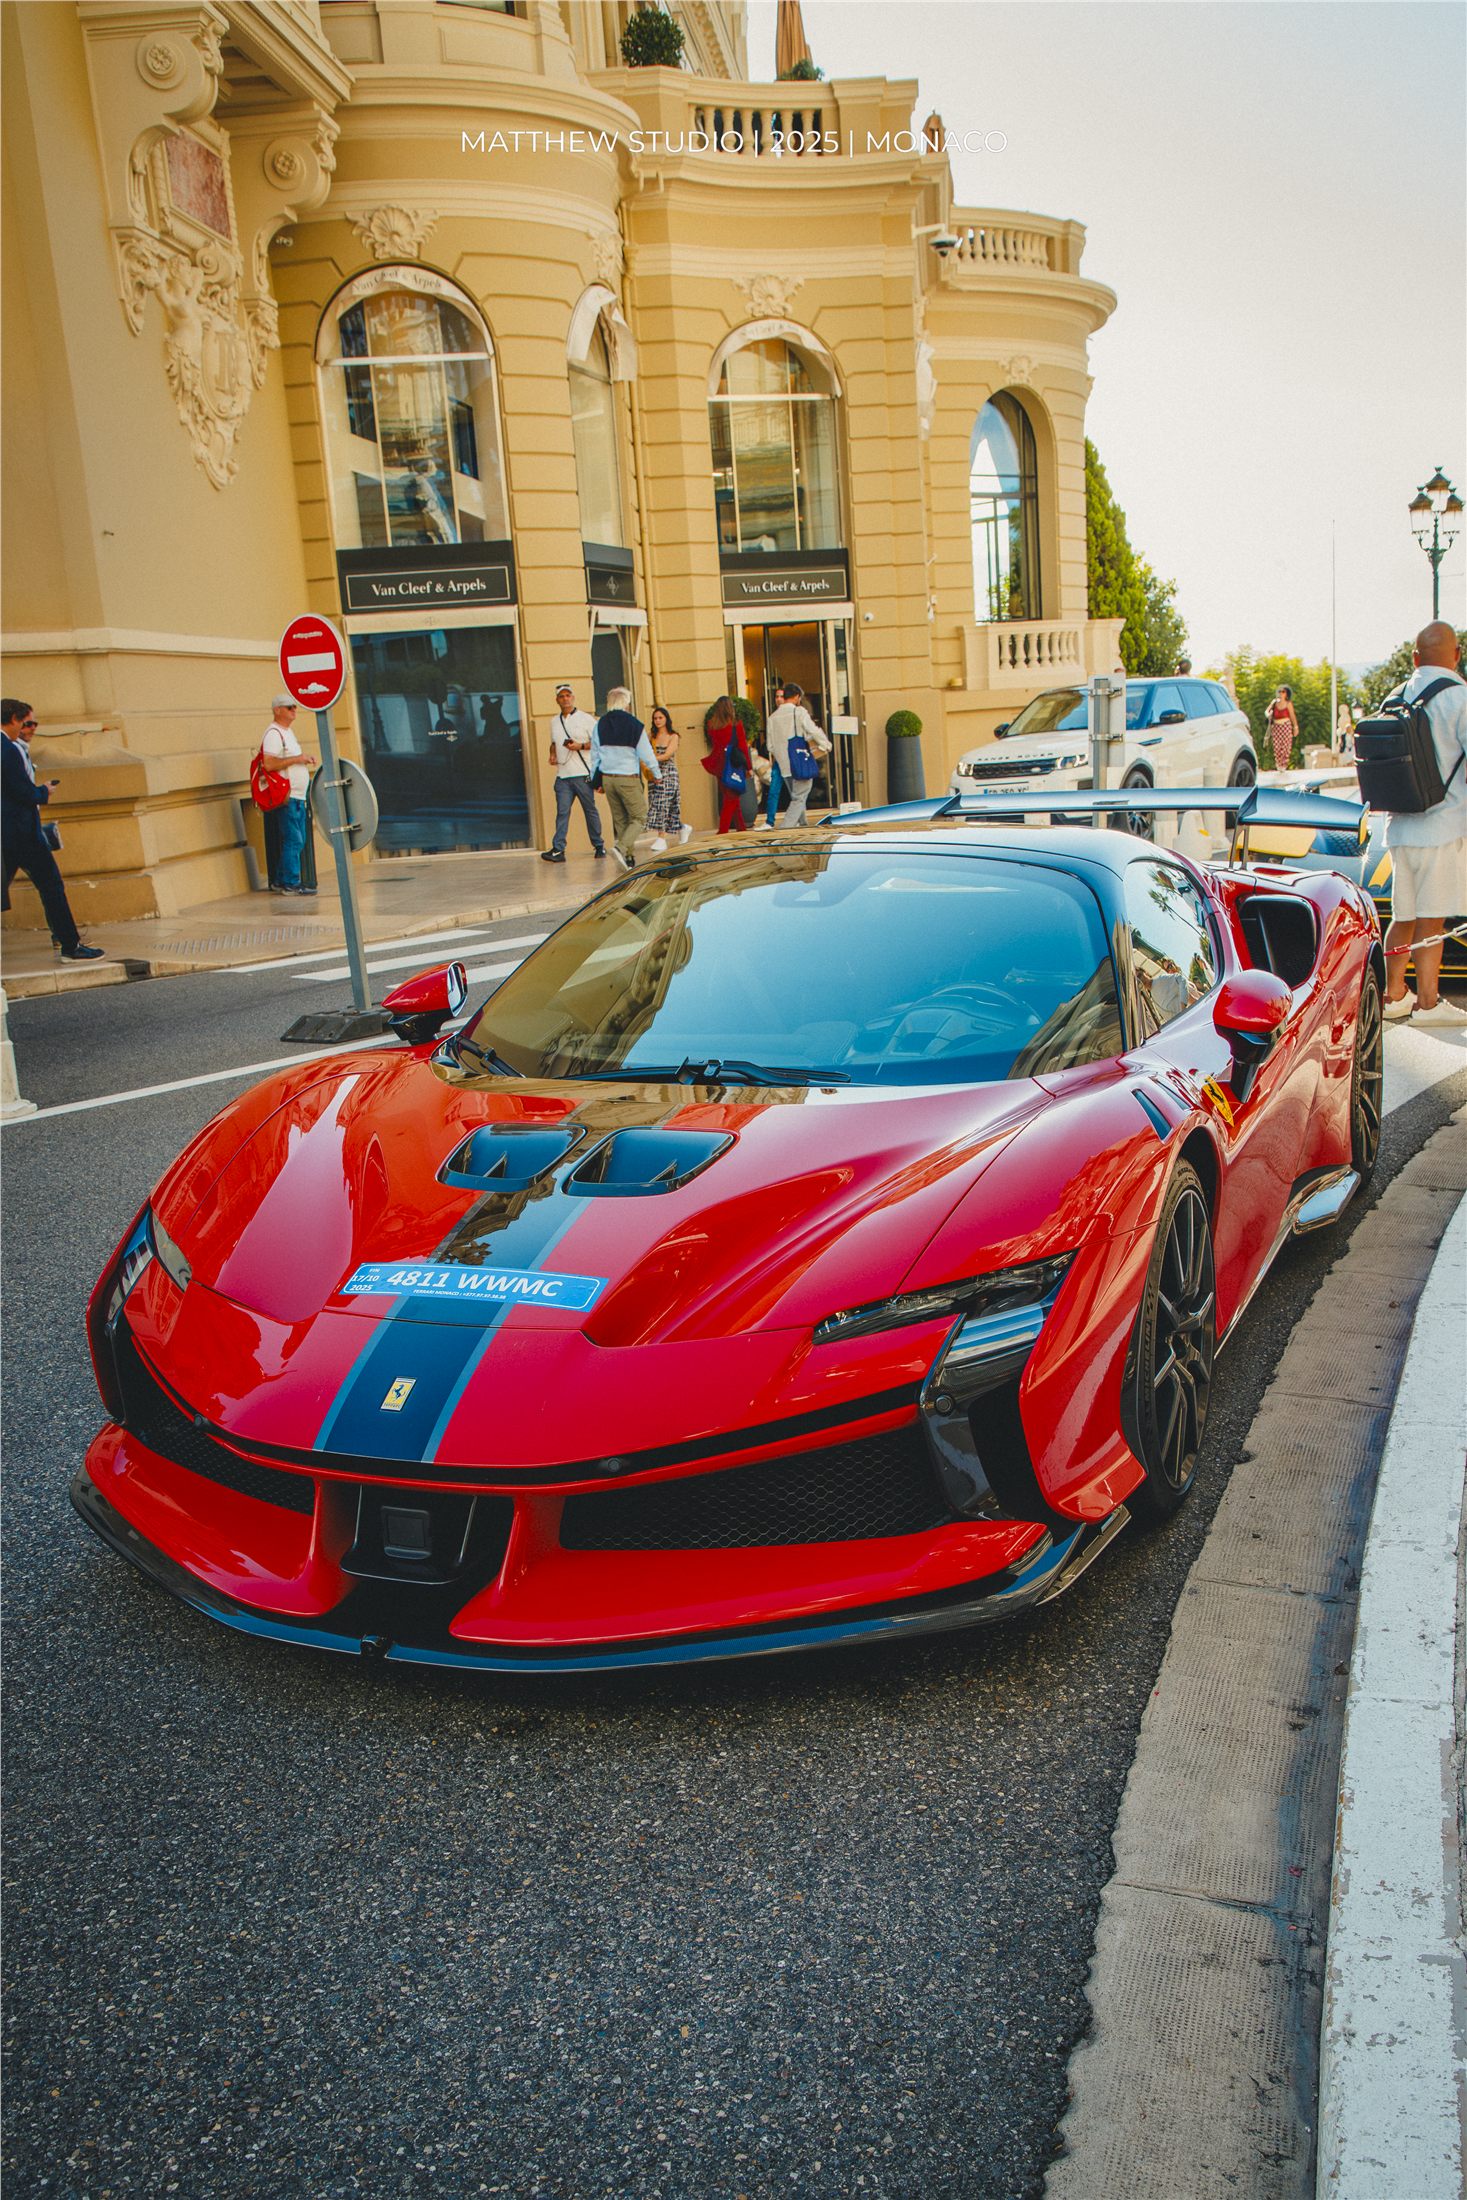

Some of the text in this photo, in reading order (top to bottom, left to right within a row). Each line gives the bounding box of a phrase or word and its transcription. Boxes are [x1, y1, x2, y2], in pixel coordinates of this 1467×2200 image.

[371, 577, 487, 597] Van Cleef & Arpels
[741, 579, 830, 593] Van Cleef & Arpels
[352, 1274, 380, 1283] 17/10
[386, 1270, 564, 1298] 4811 WWMC
[349, 1284, 374, 1292] 2025
[1144, 1320, 1152, 1401] MICHELIN
